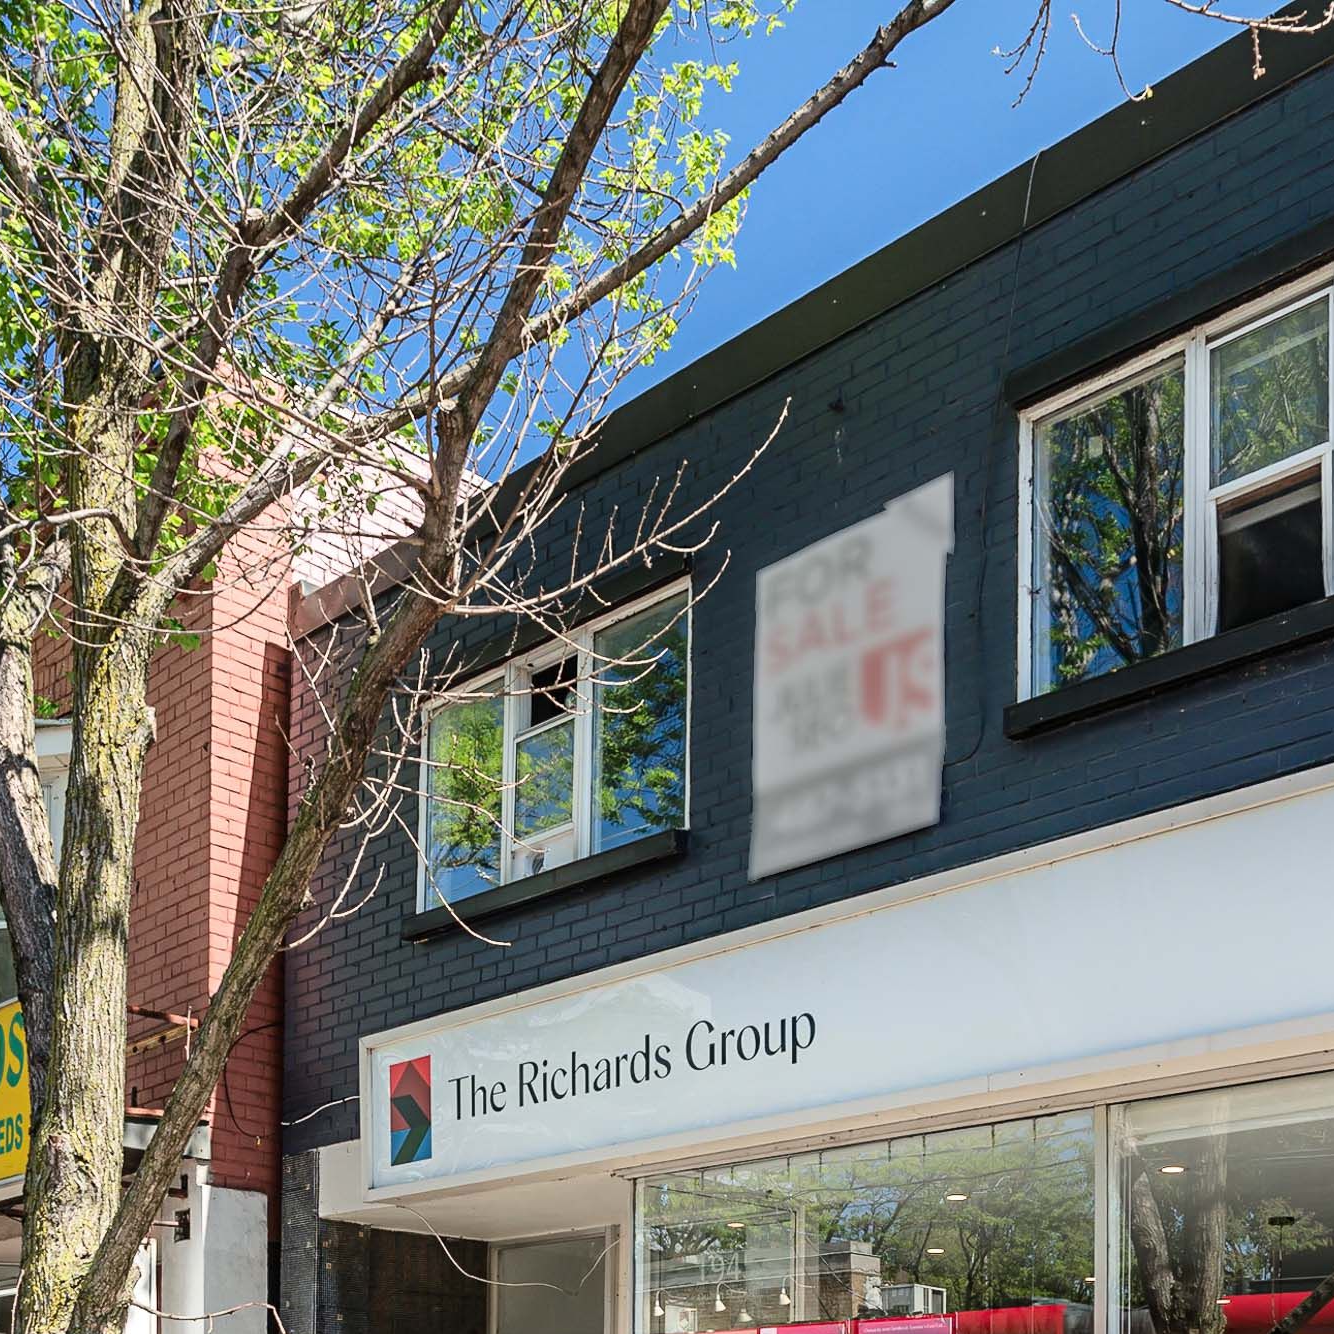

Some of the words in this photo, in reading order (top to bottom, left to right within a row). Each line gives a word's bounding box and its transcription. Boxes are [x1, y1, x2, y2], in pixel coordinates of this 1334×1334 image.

[448, 1074, 508, 1120] The
[517, 1034, 672, 1107] Richards
[685, 1011, 817, 1072] Group
